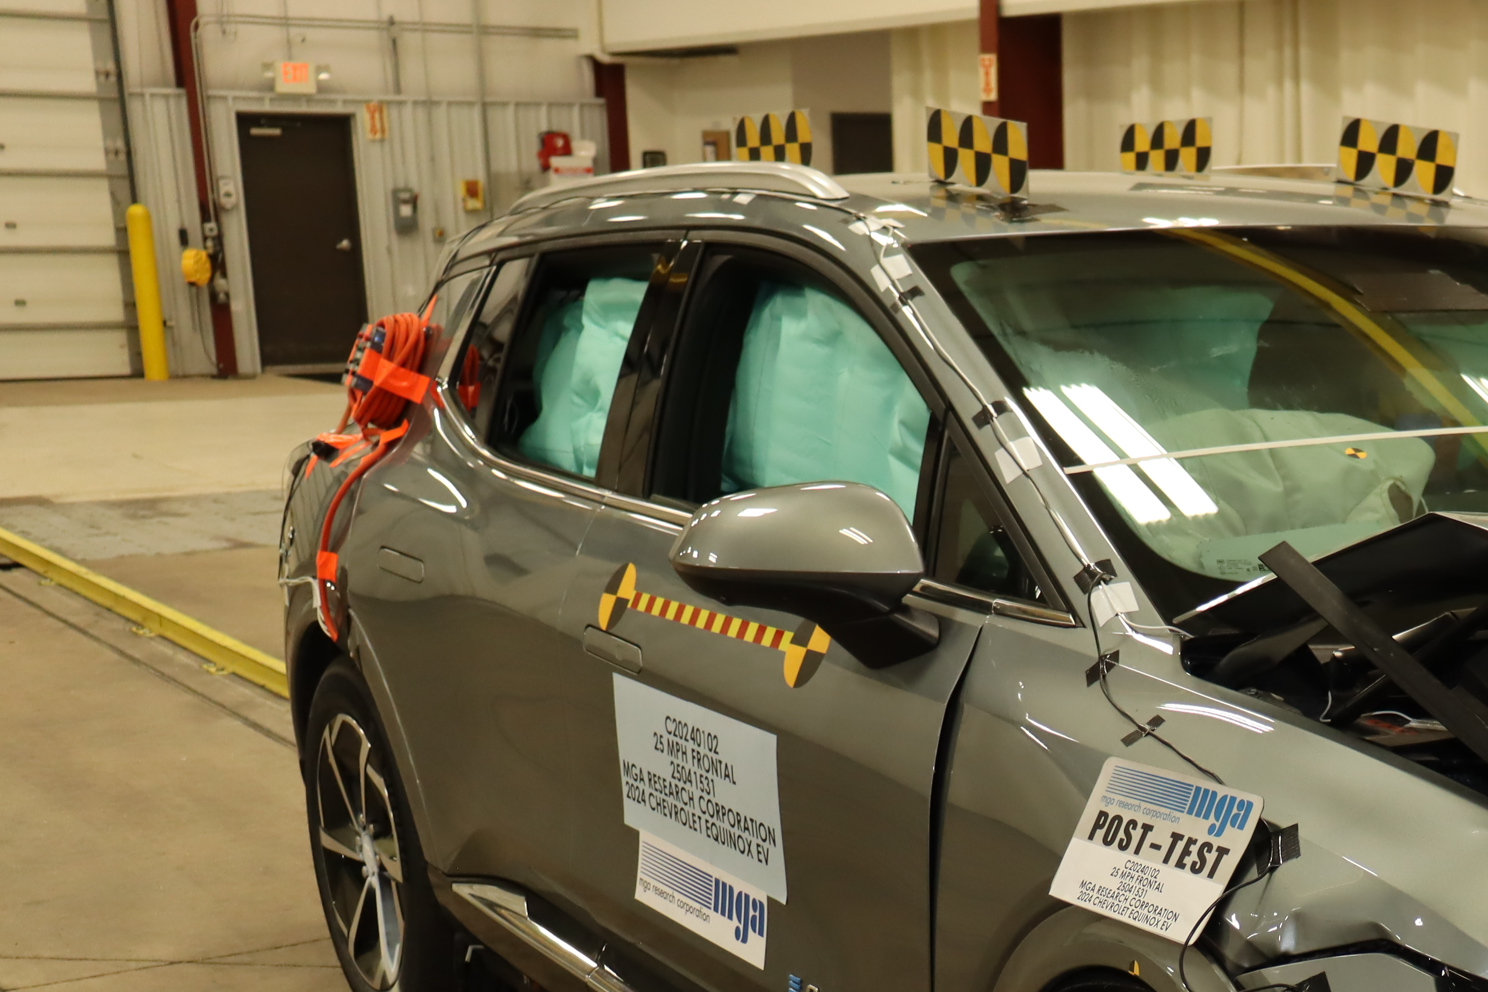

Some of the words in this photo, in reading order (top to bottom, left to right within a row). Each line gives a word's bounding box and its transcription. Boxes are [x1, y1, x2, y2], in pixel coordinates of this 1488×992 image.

[664, 715, 720, 755] C20240102
[653, 732, 665, 754] 25
[667, 738, 689, 764] MPH
[691, 748, 737, 785] FRONTAL
[670, 761, 716, 798] 25041531
[622, 759, 646, 786] MGA
[647, 770, 696, 809] RESEARCH
[698, 795, 777, 848] CORPORATION
[625, 781, 647, 807] 2024
[648, 792, 703, 834] CHEVROLET
[705, 819, 754, 859] EQUINOX
[756, 843, 770, 866] EV
[1101, 795, 1116, 807] mga
[1116, 799, 1142, 813] research
[1142, 806, 1181, 824] corporation
[1186, 785, 1254, 838] mga
[1087, 810, 1231, 879] POST-TEST
[1110, 867, 1120, 877] 25
[1119, 870, 1136, 883] MPH
[1135, 874, 1164, 893] FRONTAL
[1117, 881, 1148, 899] 25041531
[1124, 859, 1161, 879] C20240102
[639, 877, 652, 893] mga
[652, 885, 675, 904] research
[676, 898, 711, 924] corporation
[713, 877, 765, 944] mga
[1077, 890, 1093, 903] 2024
[1092, 896, 1130, 916] CHEVROLET
[1128, 909, 1162, 928] EQUINOX
[1160, 920, 1172, 932] EV
[1079, 879, 1096, 893] MGA
[1096, 885, 1128, 904] RESEARCH
[1129, 897, 1180, 923] CORPORATION
